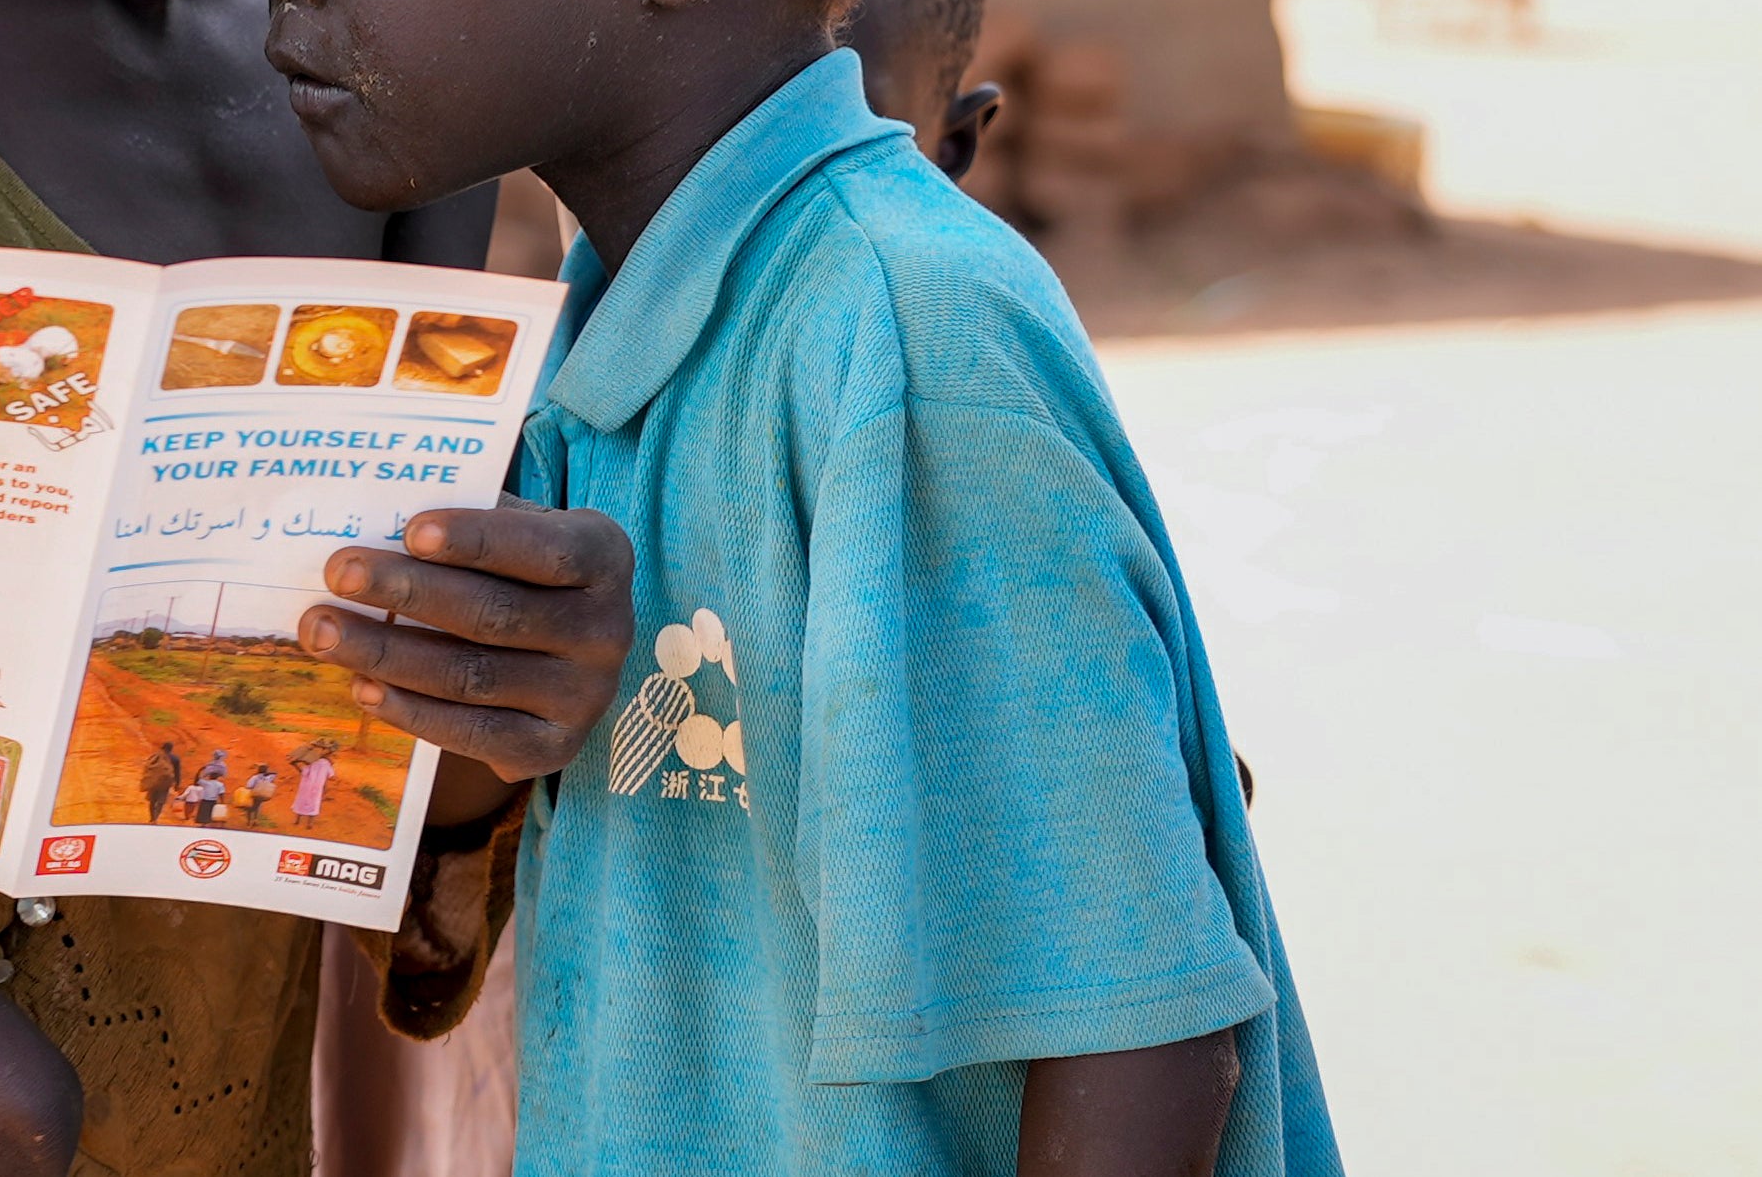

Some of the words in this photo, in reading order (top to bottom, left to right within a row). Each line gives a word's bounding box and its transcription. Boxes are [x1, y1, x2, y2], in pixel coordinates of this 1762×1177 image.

[4, 372, 98, 422] SAFE
[141, 431, 225, 456] KEEP
[237, 429, 406, 450] YOURSELF
[414, 434, 485, 455] AND
[13, 463, 36, 473] an
[152, 460, 238, 483] YOUR
[249, 460, 368, 479] FAMILY
[374, 462, 459, 484] SAFE
[10, 478, 30, 489] to
[35, 483, 74, 499] you,
[10, 496, 70, 514] report
[160, 507, 245, 540] اسرتك
[252, 516, 271, 540] و
[282, 508, 362, 539] نفسك
[315, 858, 379, 885] MAG
